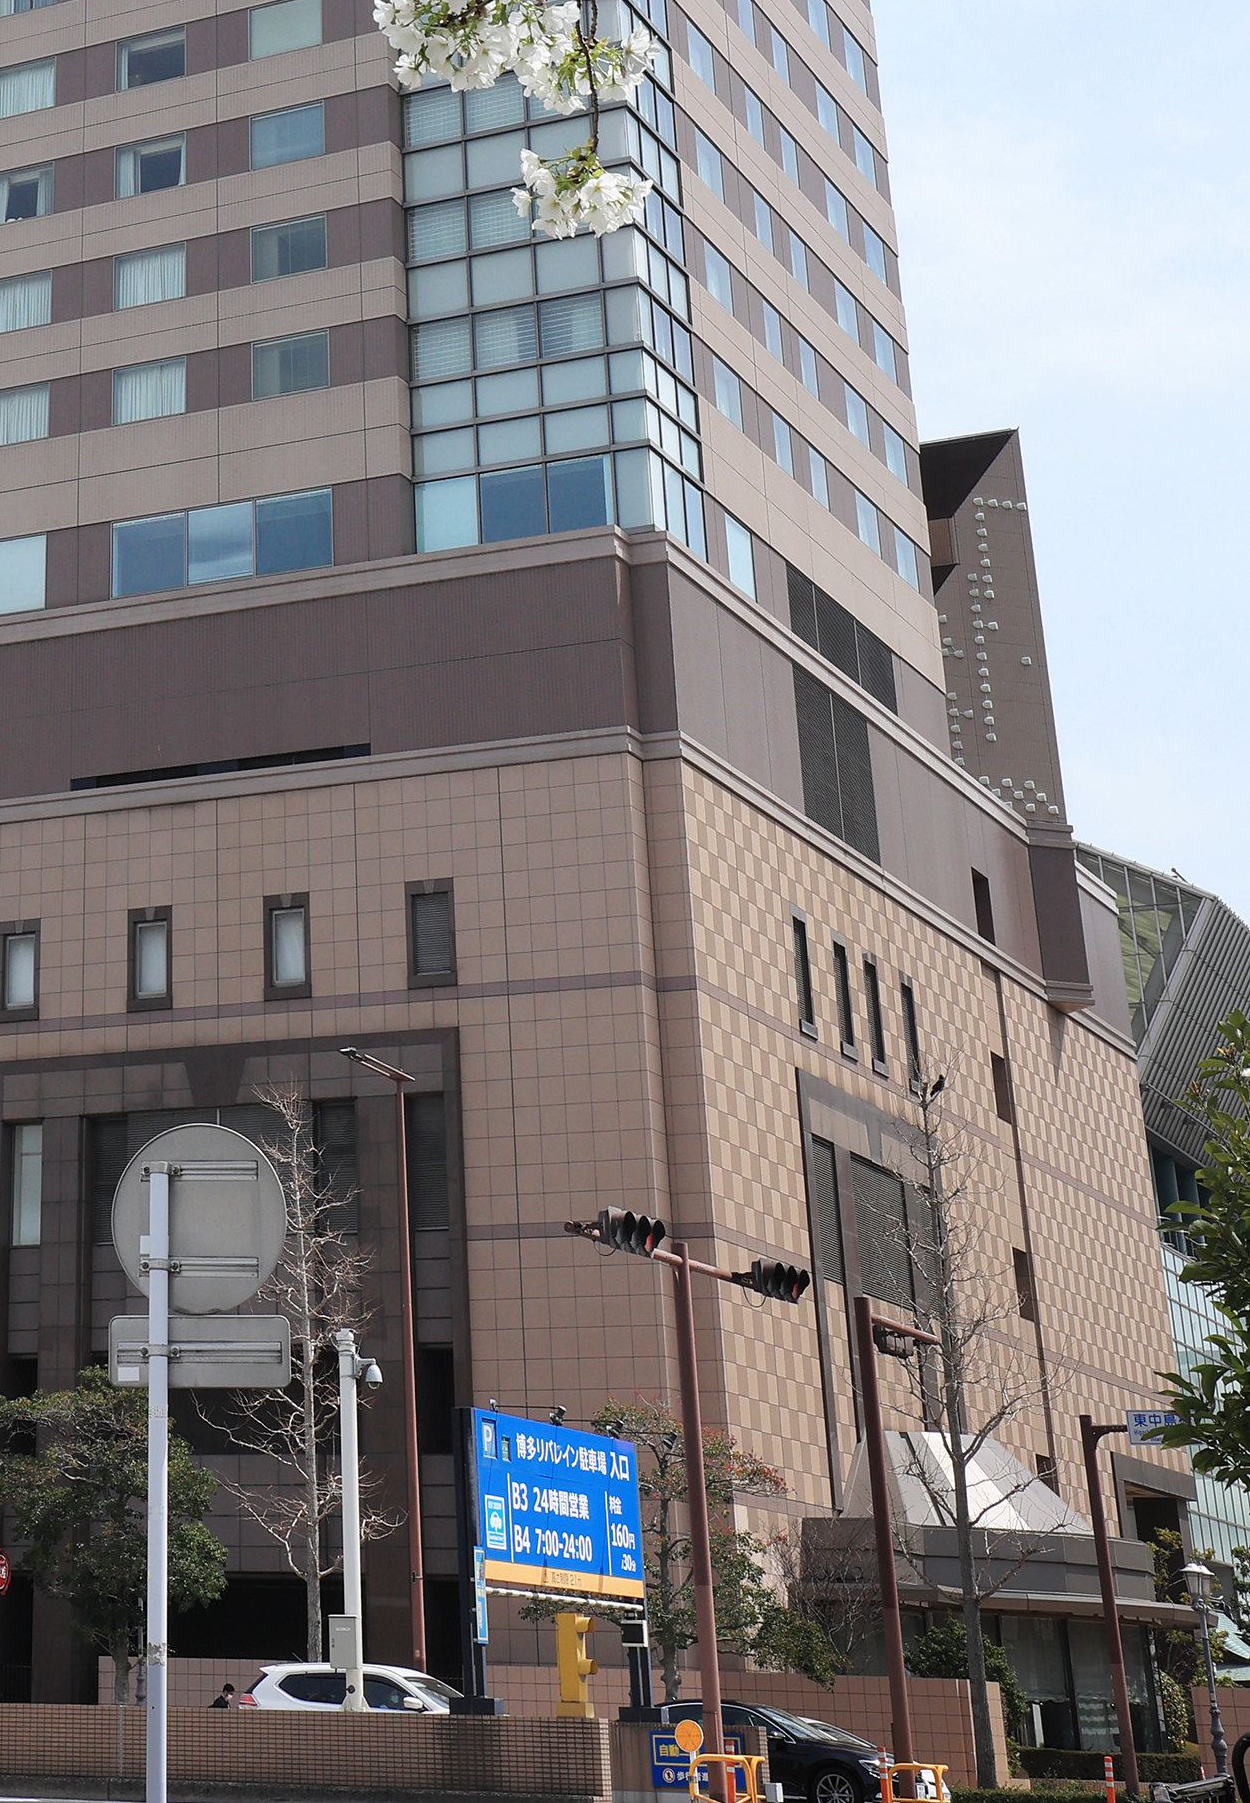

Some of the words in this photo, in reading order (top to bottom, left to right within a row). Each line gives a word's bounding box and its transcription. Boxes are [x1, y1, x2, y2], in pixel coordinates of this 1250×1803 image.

[1133, 1413, 1186, 1427] 東中島
[516, 1432, 607, 1476] 博多リバレイン駐車場
[610, 1451, 630, 1482] 入口
[511, 1481, 529, 1512] B3
[533, 1486, 590, 1520] 24時間営業
[609, 1495, 623, 1516] 料金
[513, 1524, 531, 1555] B4
[535, 1527, 593, 1563] 7:00-24:00
[611, 1522, 636, 1551] 160円
